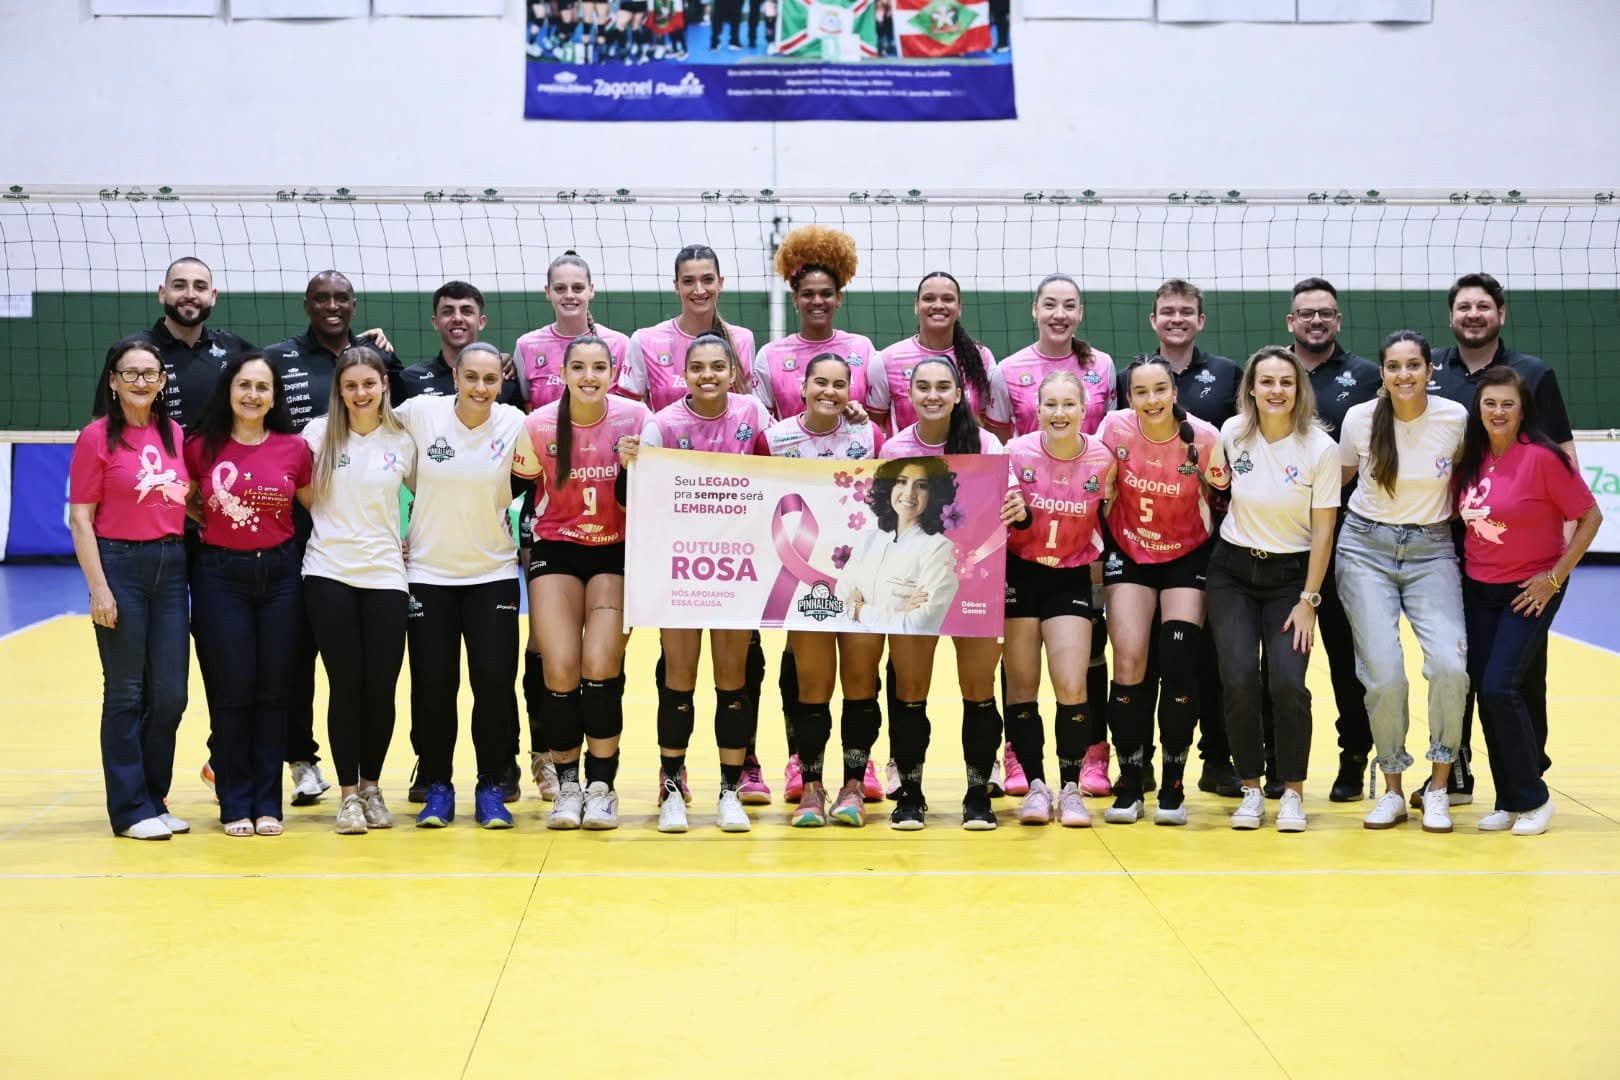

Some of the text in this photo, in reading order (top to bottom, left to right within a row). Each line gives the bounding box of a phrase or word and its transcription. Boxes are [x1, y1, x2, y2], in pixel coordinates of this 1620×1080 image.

[593, 79, 652, 100] Zagonel
[569, 462, 619, 482] agonel
[674, 475, 750, 488] Seu LEGADO
[1124, 469, 1181, 495] Zagonel
[1584, 465, 1620, 496] Za
[582, 487, 597, 516] 9
[674, 490, 764, 502] pra sempre será
[1029, 492, 1088, 515] Zagonel
[674, 503, 748, 515] LEMBRADO!
[1139, 497, 1154, 523] 5
[1045, 519, 1059, 549] 1
[672, 540, 756, 556] OUTUBRO
[671, 555, 759, 582] ROSA
[671, 589, 736, 599] NÓS APOIAMOS
[671, 599, 722, 607] ESSA CAUSA
[797, 599, 844, 613] PINHALENSE
[961, 601, 987, 609] Débora
